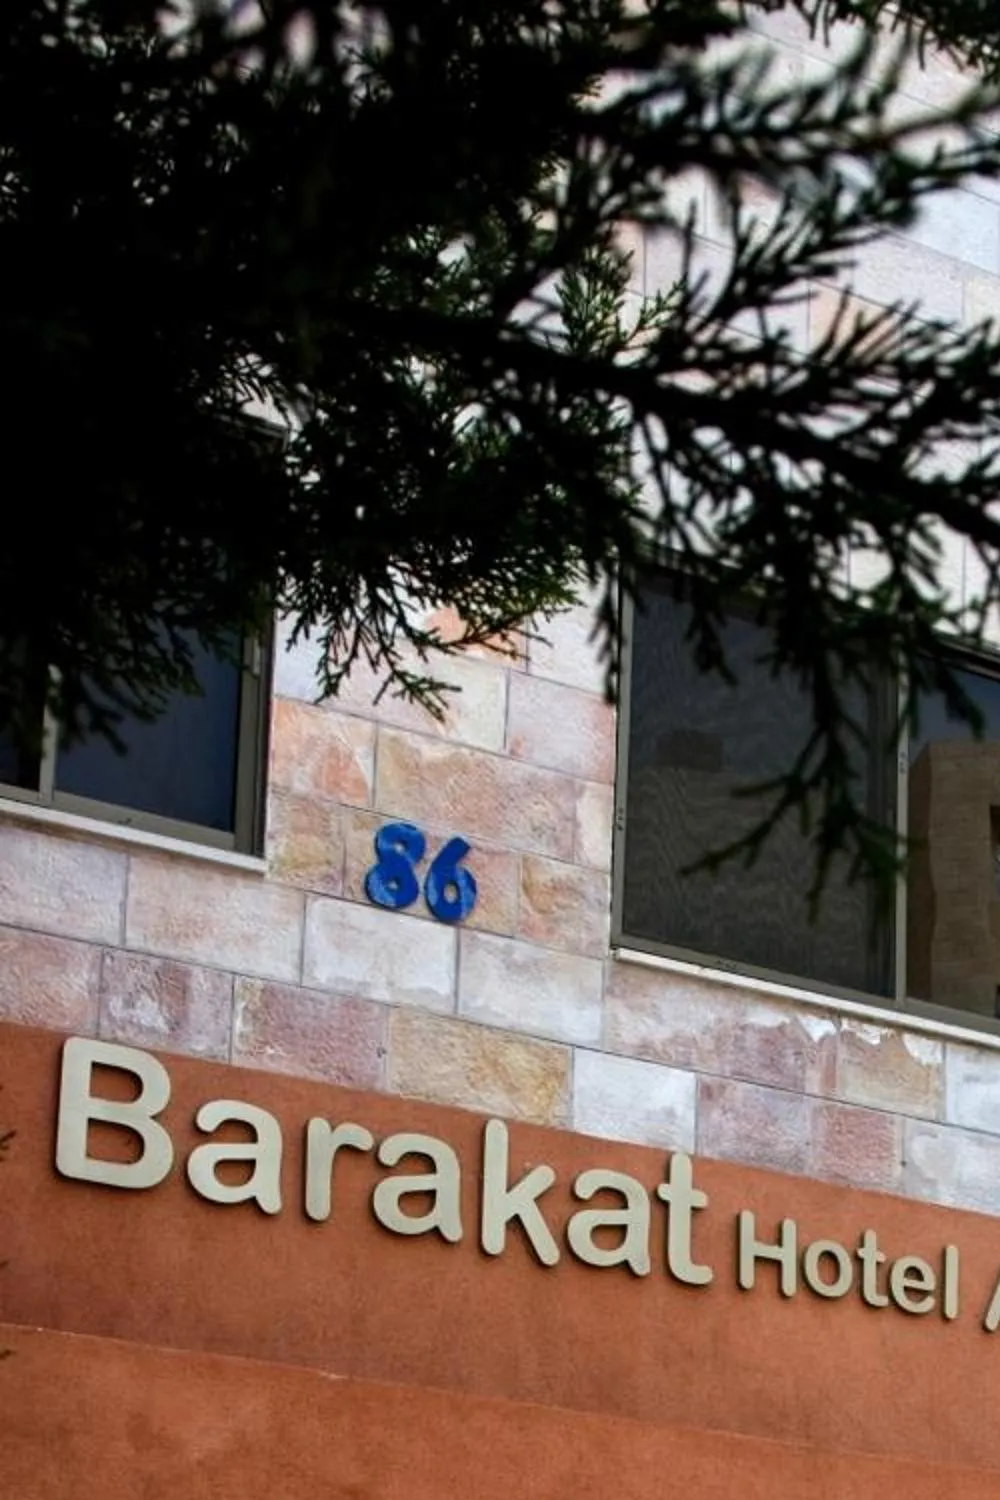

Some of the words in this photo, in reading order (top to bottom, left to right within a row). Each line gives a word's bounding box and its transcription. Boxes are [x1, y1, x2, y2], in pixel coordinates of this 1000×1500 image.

[364, 822, 477, 925] 86
[55, 1036, 714, 1287] Barakat
[738, 1209, 960, 1320] Hotel
